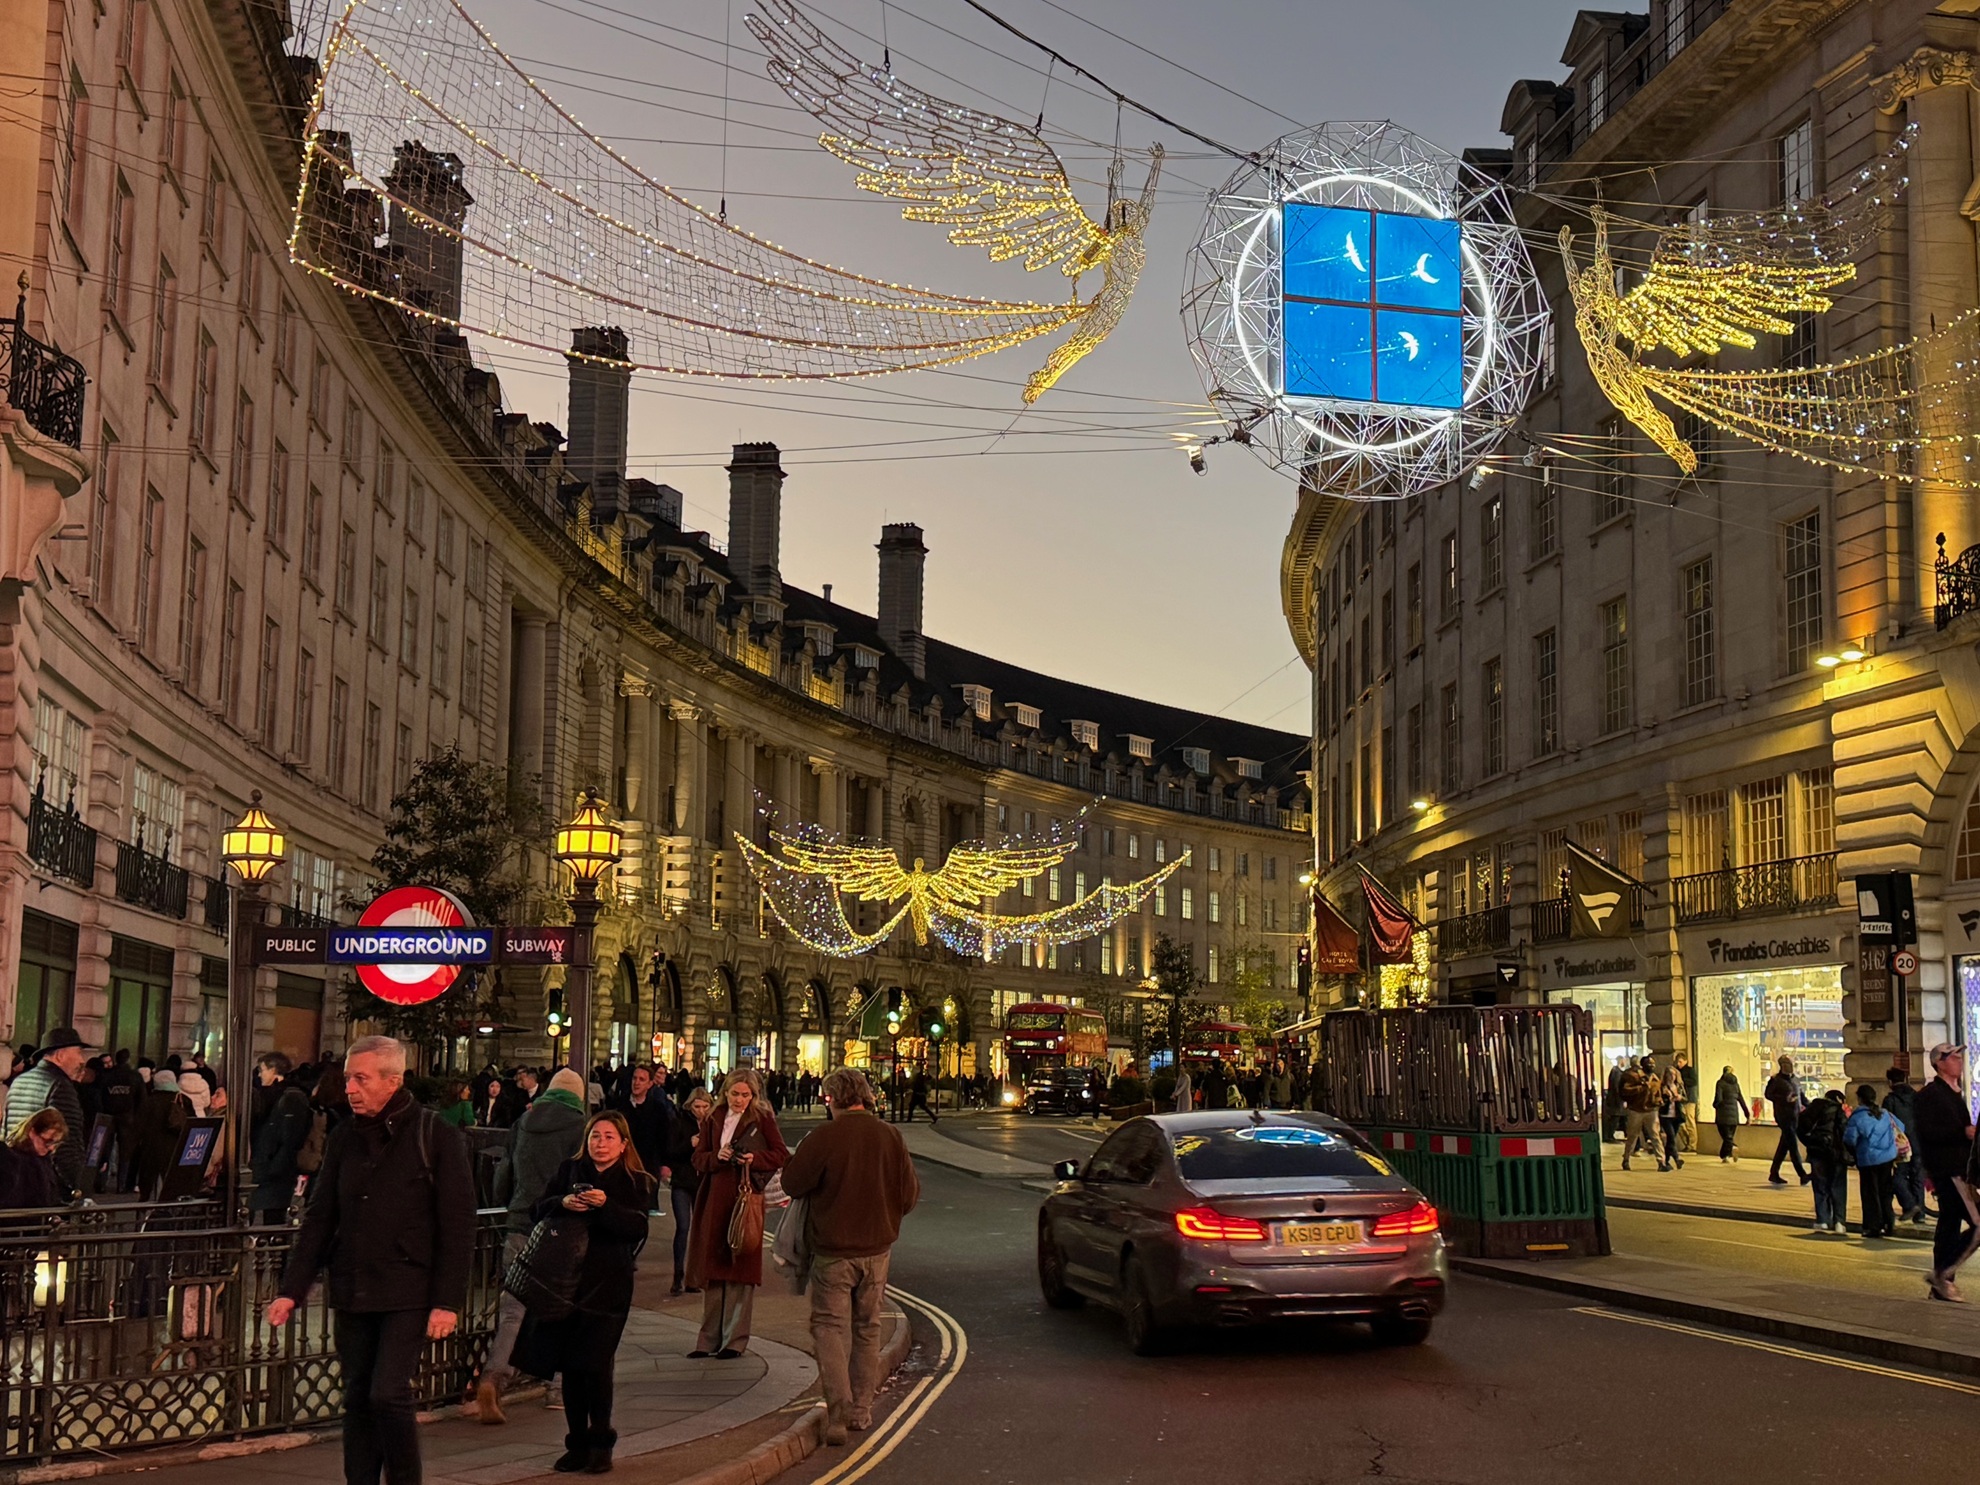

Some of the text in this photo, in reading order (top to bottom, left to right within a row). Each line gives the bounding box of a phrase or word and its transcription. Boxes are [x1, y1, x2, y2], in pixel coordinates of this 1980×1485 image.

[266, 937, 565, 955] PUBLIC UNDERGROUND SUBWAY
[1722, 937, 1830, 962] Fanatics Collectibles
[1564, 959, 1594, 978] Fanatics
[1595, 956, 1637, 975] Collectibles
[1897, 958, 1914, 969] 20
[1863, 979, 1886, 990] REGENT
[1746, 993, 1806, 1016] THE GIFT
[1863, 992, 1886, 1003] STREET
[1746, 1014, 1807, 1032] THAT KEEPS
[107, 1085, 131, 1095] VANS
[189, 1133, 208, 1148] JW
[1288, 1226, 1356, 1243] KS19 CPU
